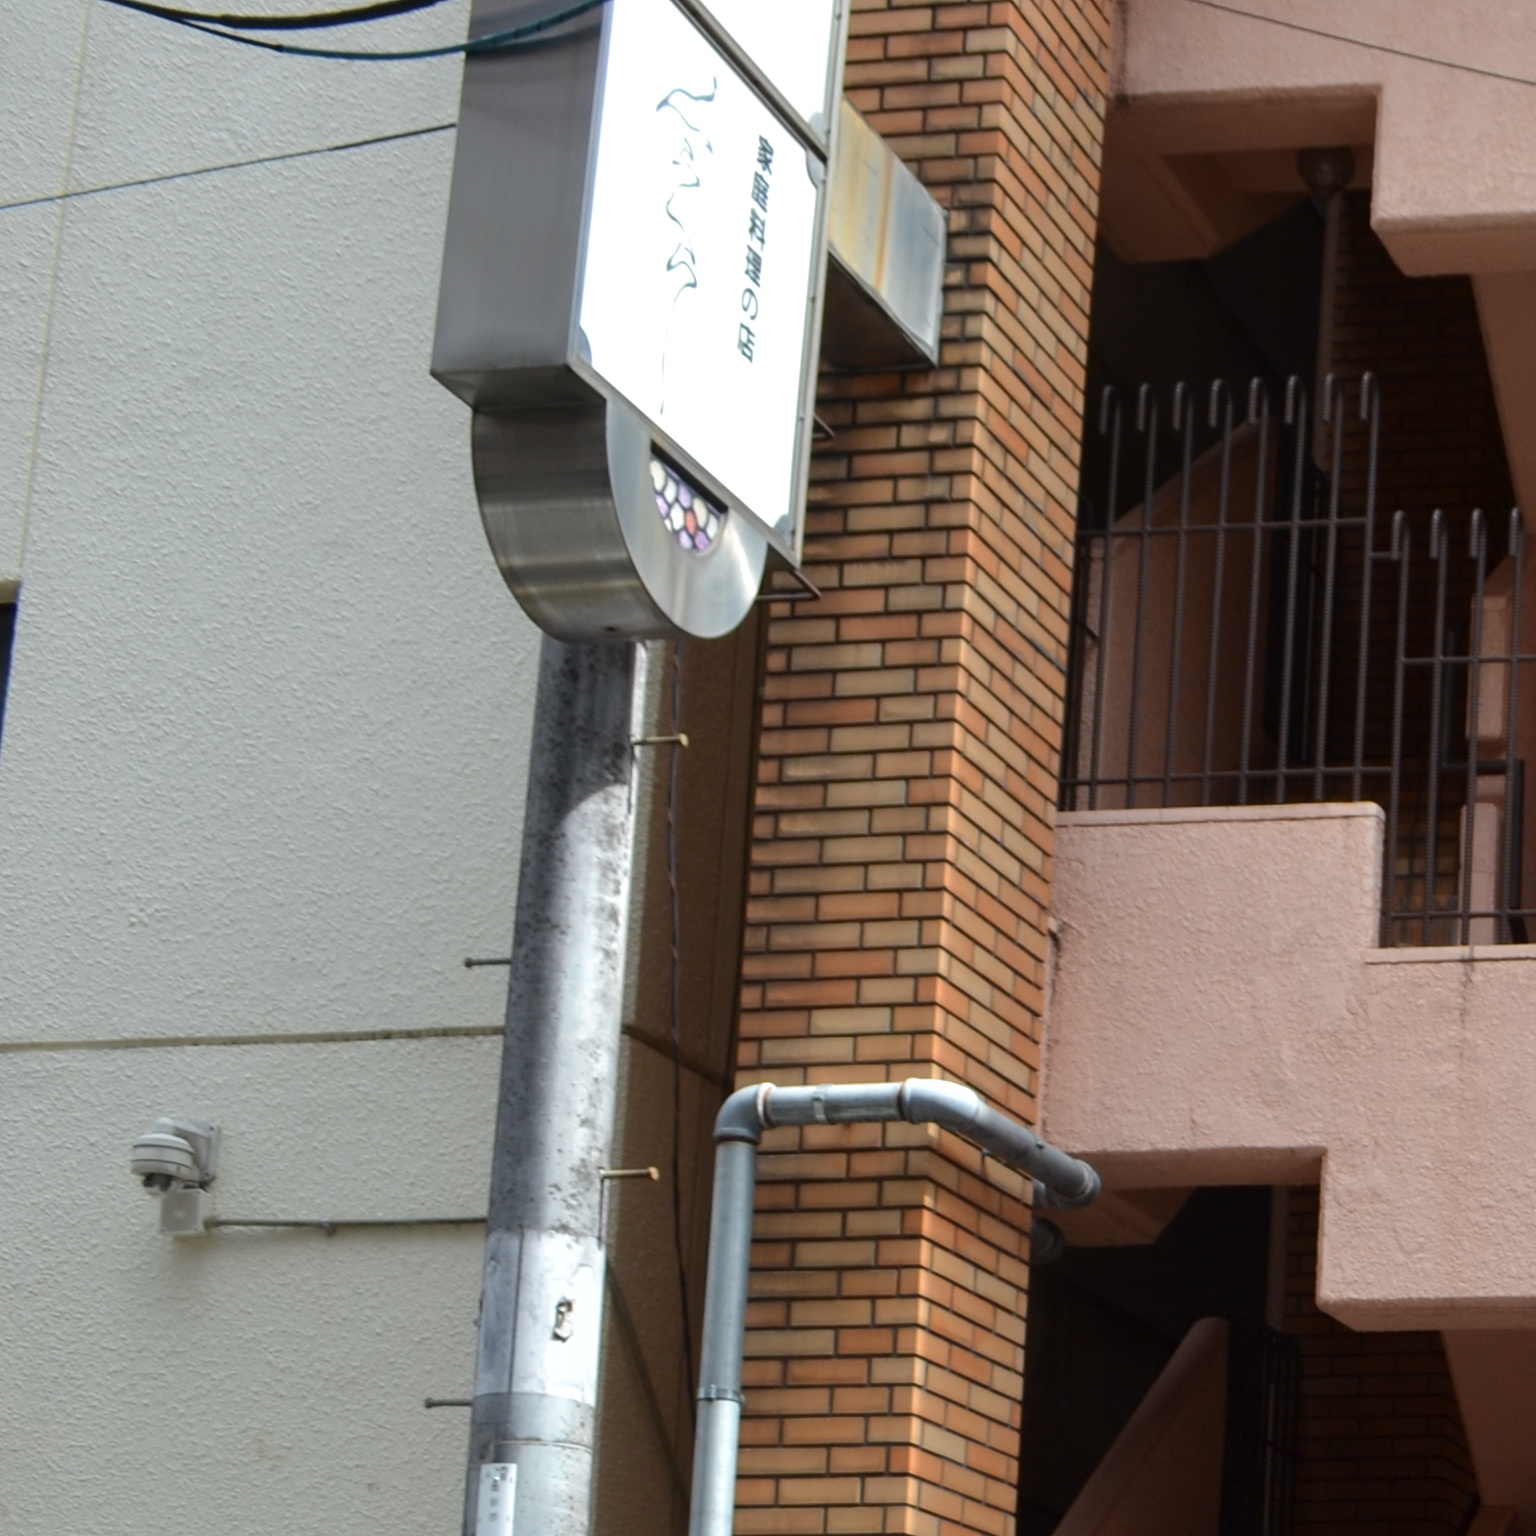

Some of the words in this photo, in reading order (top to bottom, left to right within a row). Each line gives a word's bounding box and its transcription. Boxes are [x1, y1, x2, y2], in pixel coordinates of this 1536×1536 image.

[737, 134, 775, 365] 家庭料理の店
